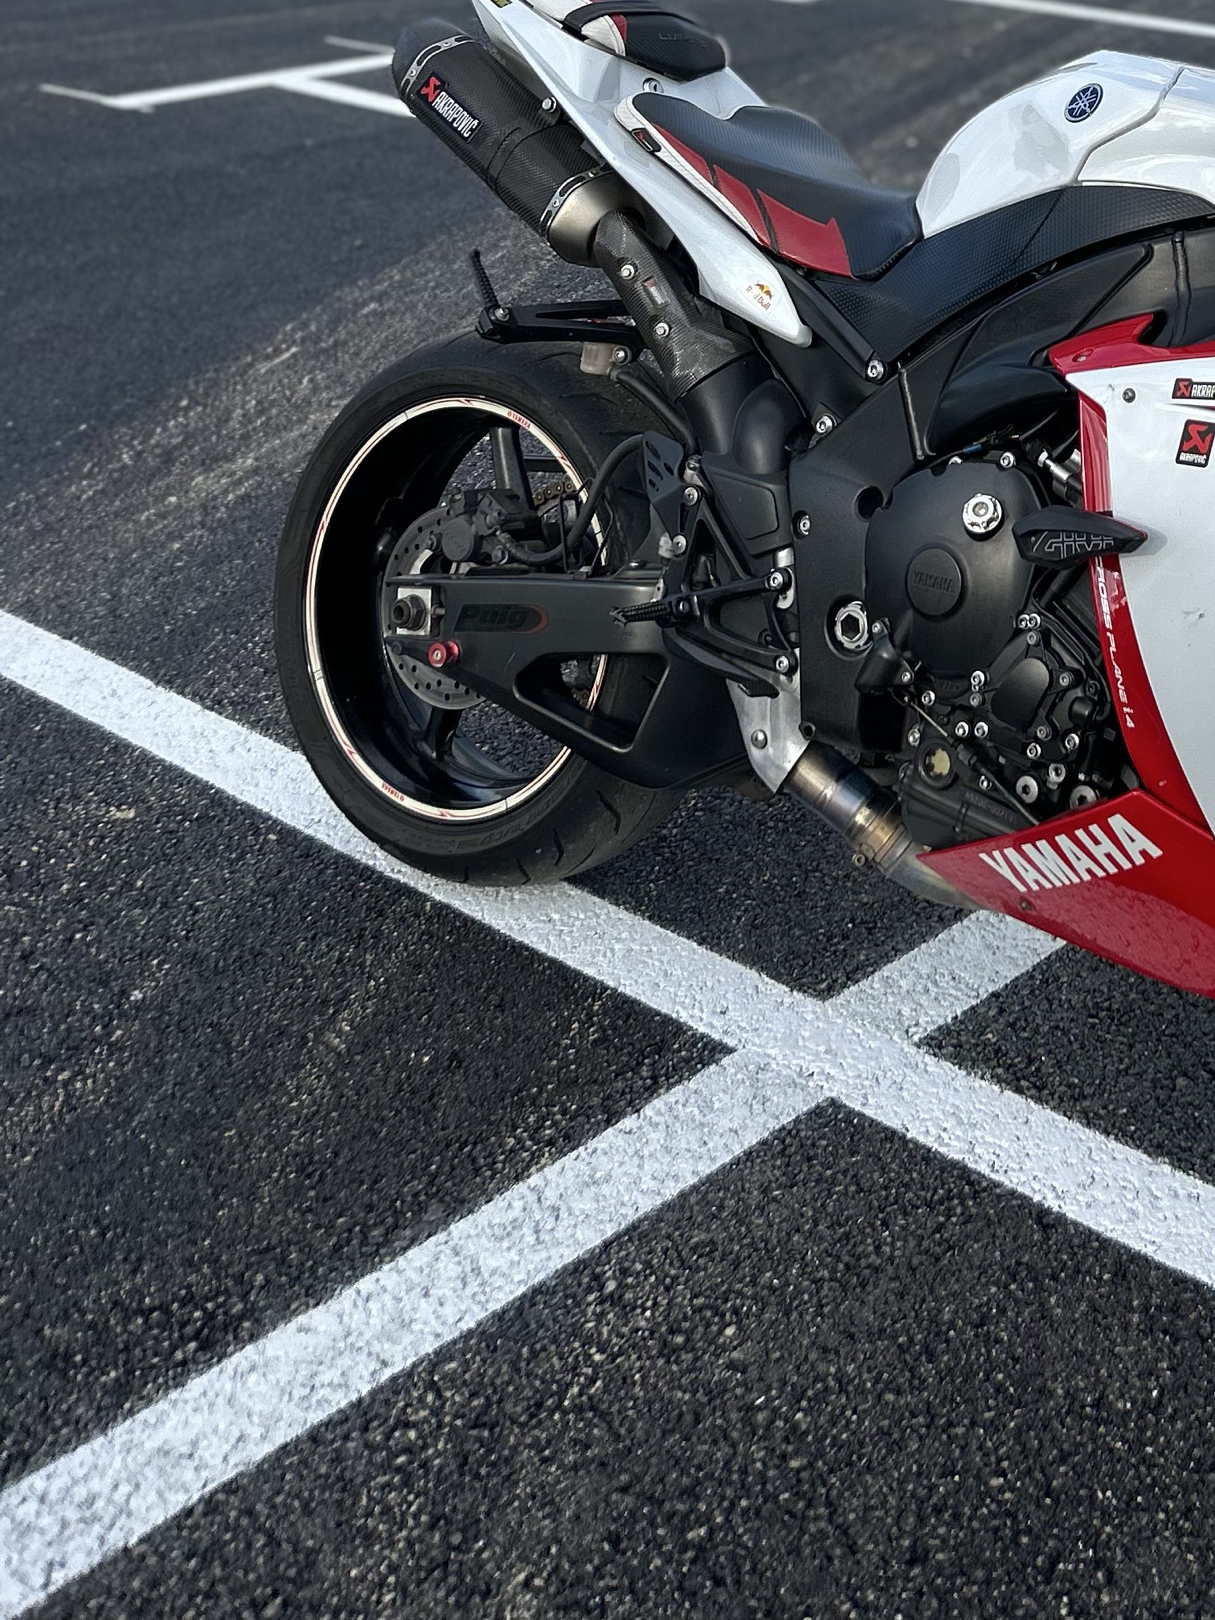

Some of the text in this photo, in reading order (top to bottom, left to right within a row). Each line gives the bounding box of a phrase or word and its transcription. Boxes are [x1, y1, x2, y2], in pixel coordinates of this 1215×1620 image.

[913, 570, 956, 595] YAMAHA
[1106, 631, 1128, 704] PLANE
[978, 812, 1163, 893] YAMAHA
